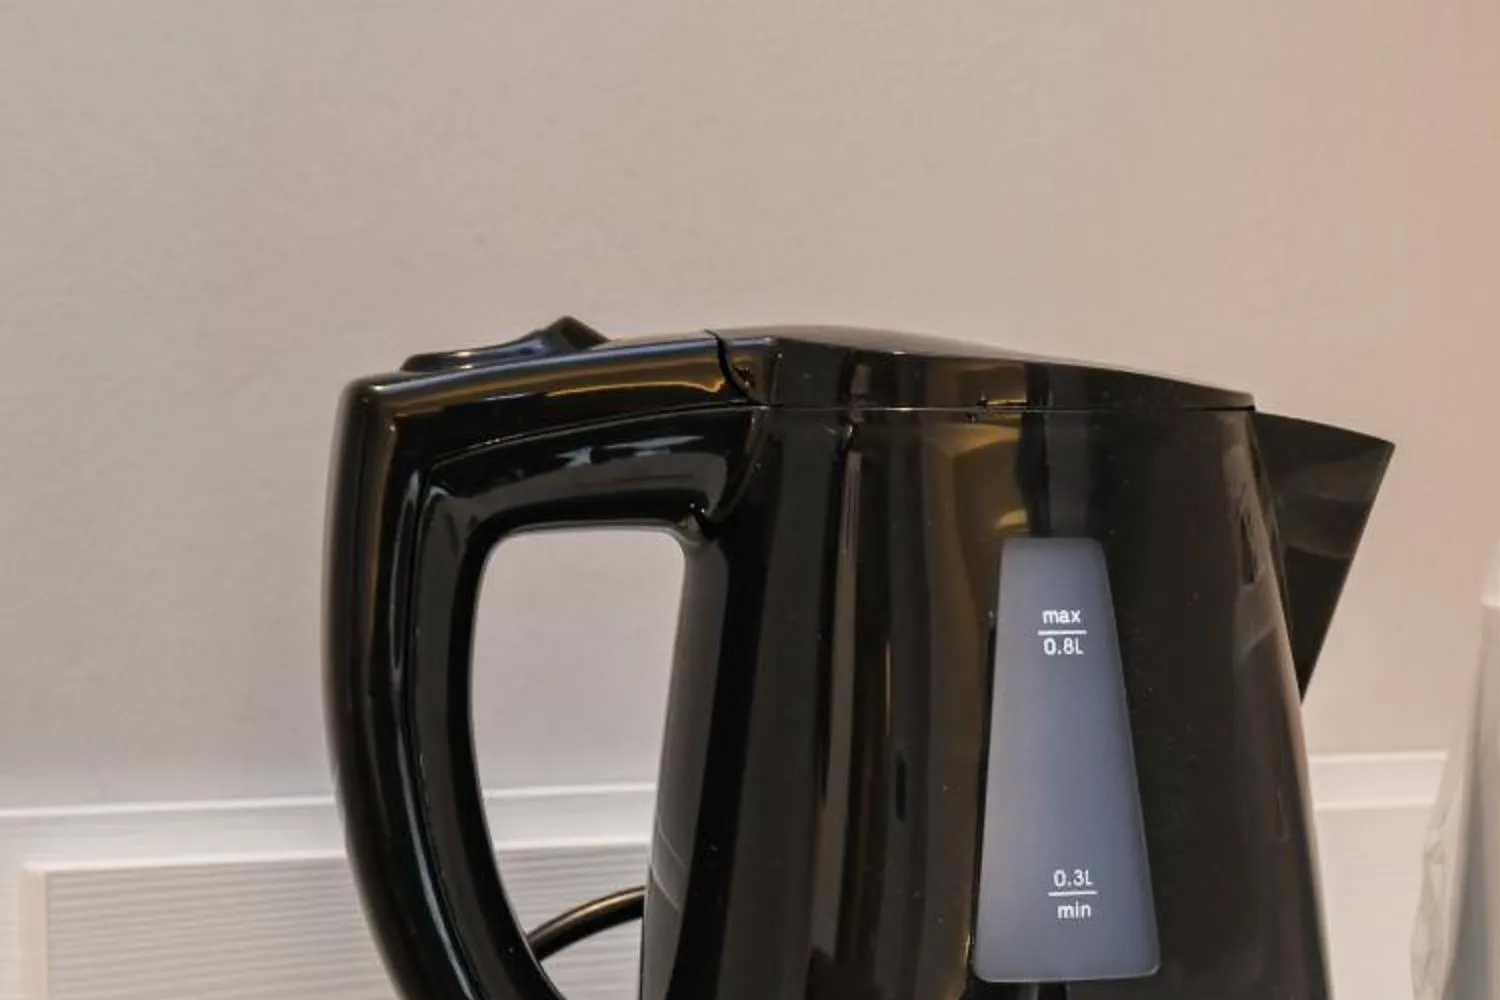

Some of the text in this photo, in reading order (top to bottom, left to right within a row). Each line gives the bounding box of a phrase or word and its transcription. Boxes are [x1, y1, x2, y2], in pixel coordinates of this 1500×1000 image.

[1042, 609, 1081, 625] max
[1043, 637, 1084, 656] 0.8L
[1053, 868, 1093, 888] 0.3L
[1057, 901, 1092, 919] min
